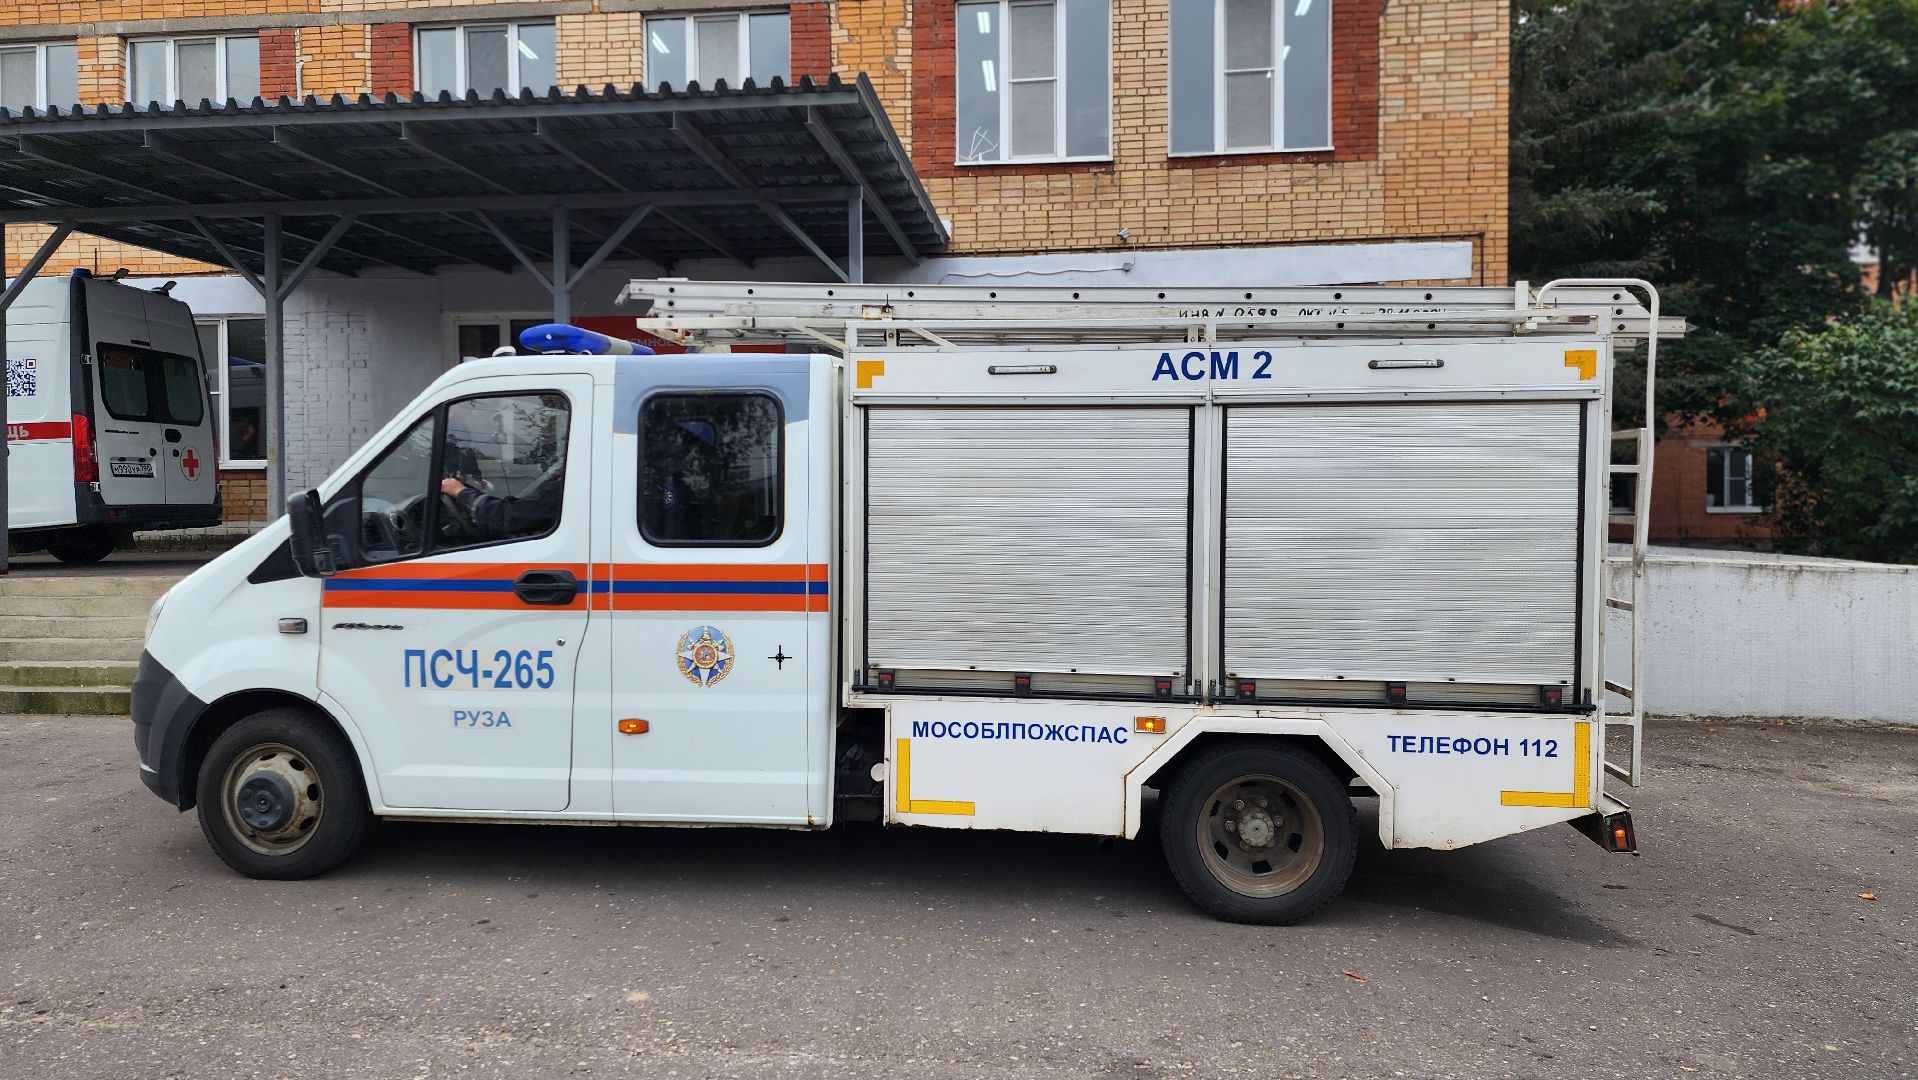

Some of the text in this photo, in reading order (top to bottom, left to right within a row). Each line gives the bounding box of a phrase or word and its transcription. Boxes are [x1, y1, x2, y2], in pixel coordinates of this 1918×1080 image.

[1151, 350, 1272, 381] АСМ 2
[404, 648, 555, 689] ПСЧ-265
[453, 710, 512, 728] РУЗА
[912, 720, 1129, 745] МОСОБЛПОЖСПАС
[1386, 734, 1558, 758] ТЕЛЕФОН 112
